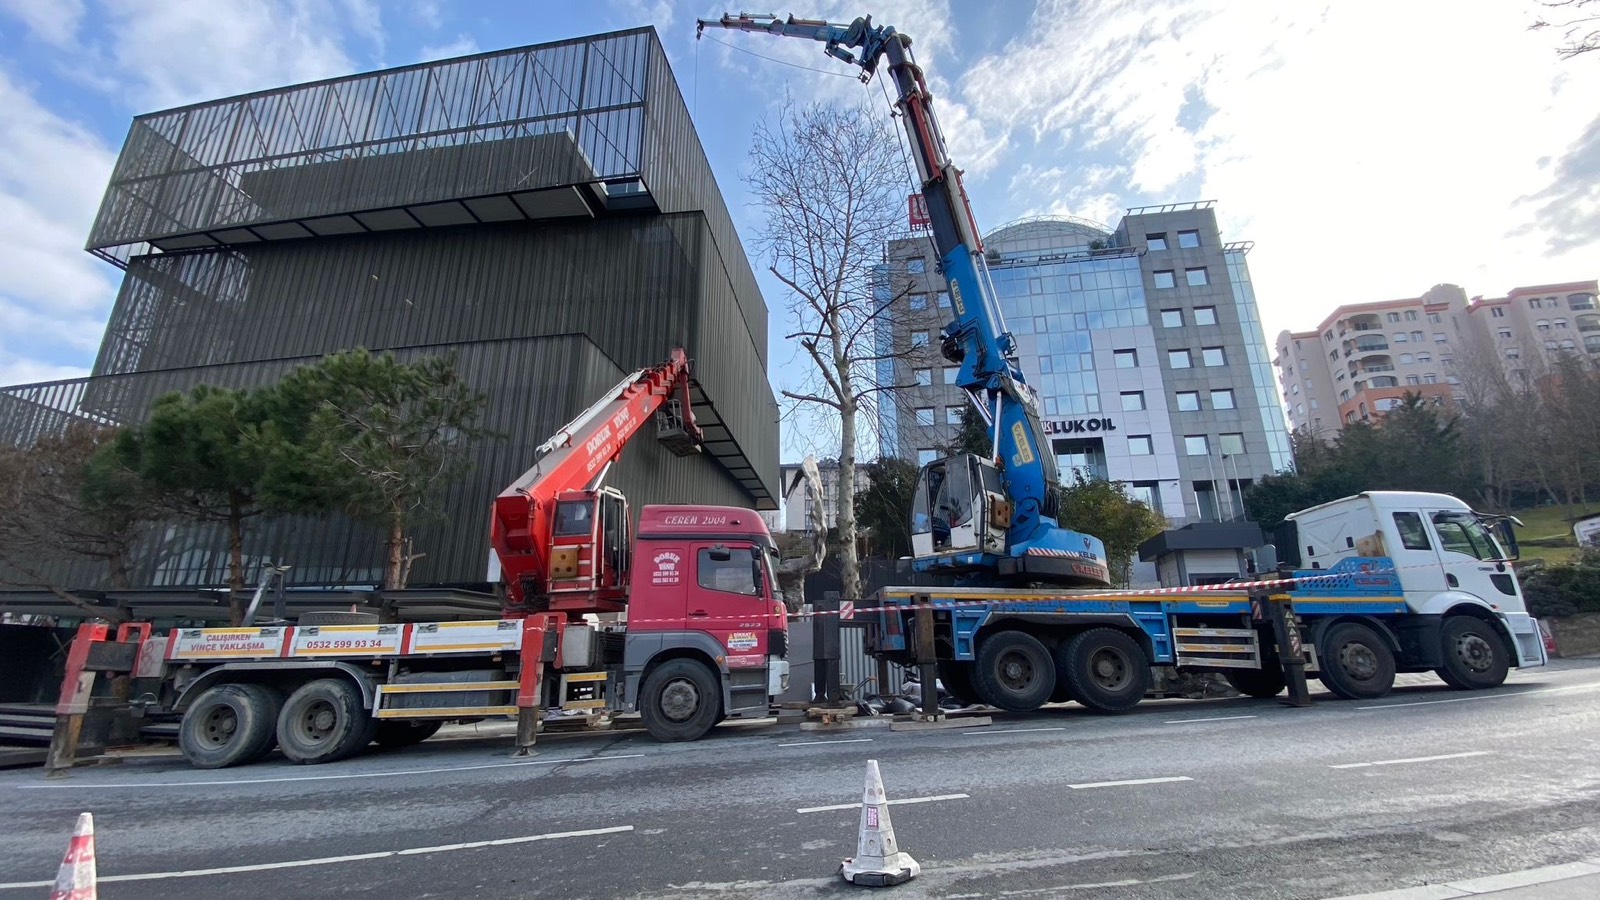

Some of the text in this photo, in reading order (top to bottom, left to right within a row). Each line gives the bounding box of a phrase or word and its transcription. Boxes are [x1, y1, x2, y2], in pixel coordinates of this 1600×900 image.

[1053, 418, 1116, 433] LUKOIL
[587, 424, 611, 456] DORUK
[1015, 432, 1031, 462] KELES
[665, 515, 726, 525] CEREN 2004
[653, 552, 681, 564] DORUK
[1079, 551, 1097, 561] KELES
[220, 642, 265, 652] YAKLAŞMA
[306, 639, 382, 649] 0532 599 93 34
